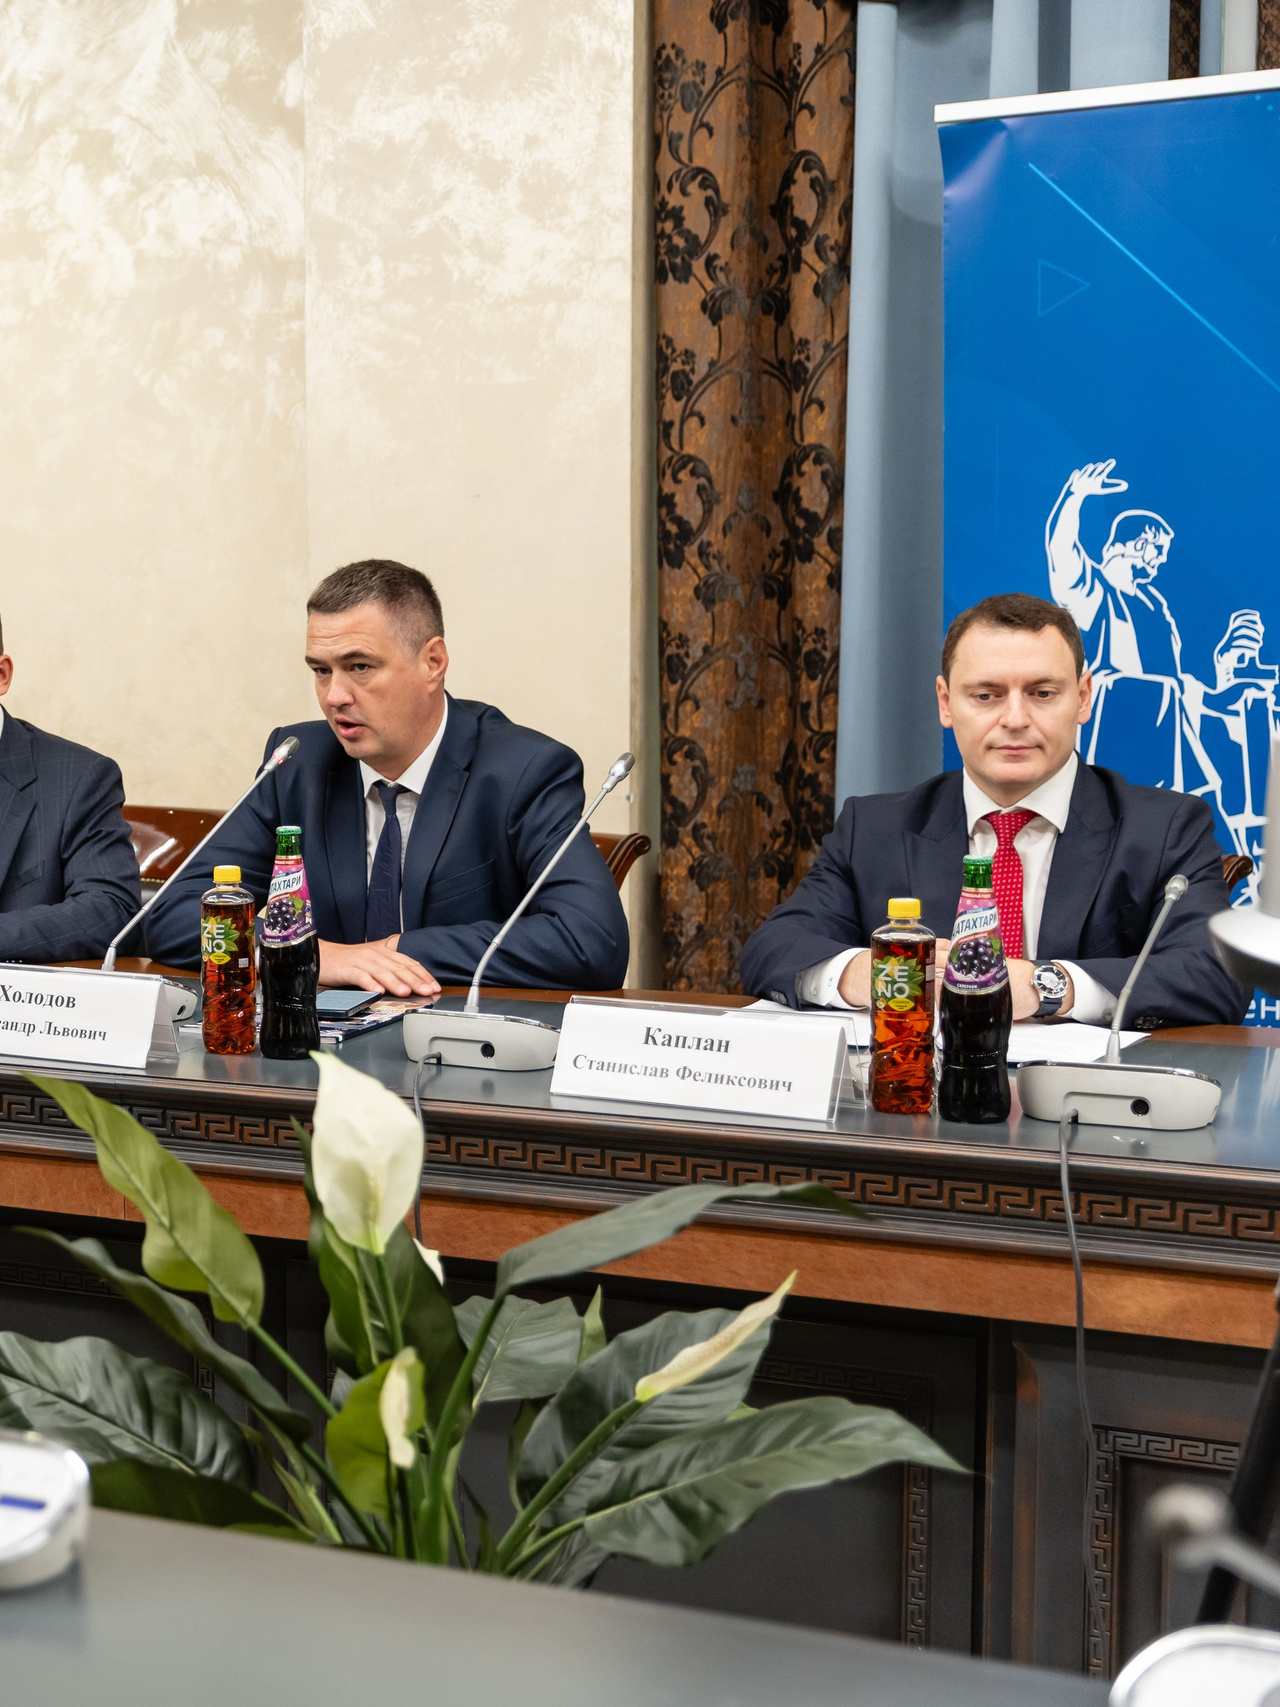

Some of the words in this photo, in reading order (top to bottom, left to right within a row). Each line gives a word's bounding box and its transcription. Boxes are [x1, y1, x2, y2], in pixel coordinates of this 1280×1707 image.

[202, 923, 226, 939] ZE
[952, 911, 998, 936] АТАХТАРИ
[203, 939, 226, 954] NO
[877, 963, 909, 982] ZE
[877, 981, 910, 999] NO
[39, 1020, 108, 1043] Львович
[642, 1026, 732, 1055] Каплан
[572, 1053, 671, 1080] Станислав
[674, 1066, 794, 1094] Феликсович
